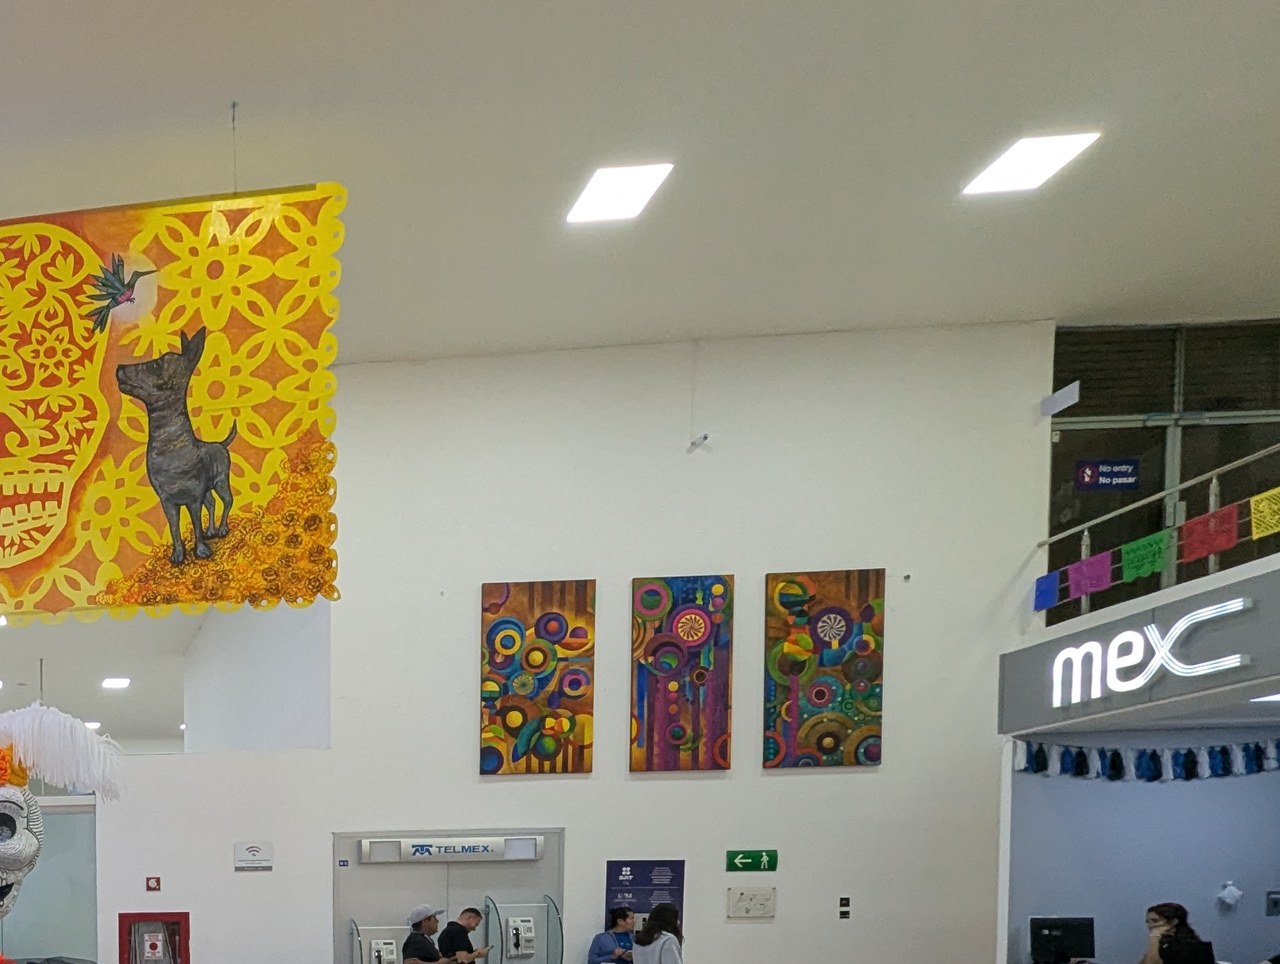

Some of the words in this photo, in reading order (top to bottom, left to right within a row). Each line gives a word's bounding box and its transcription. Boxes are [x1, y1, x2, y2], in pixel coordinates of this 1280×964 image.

[1113, 465, 1133, 473] entry
[1099, 476, 1111, 484] No
[1112, 477, 1136, 485] pasar
[435, 845, 490, 854] TELMEX
